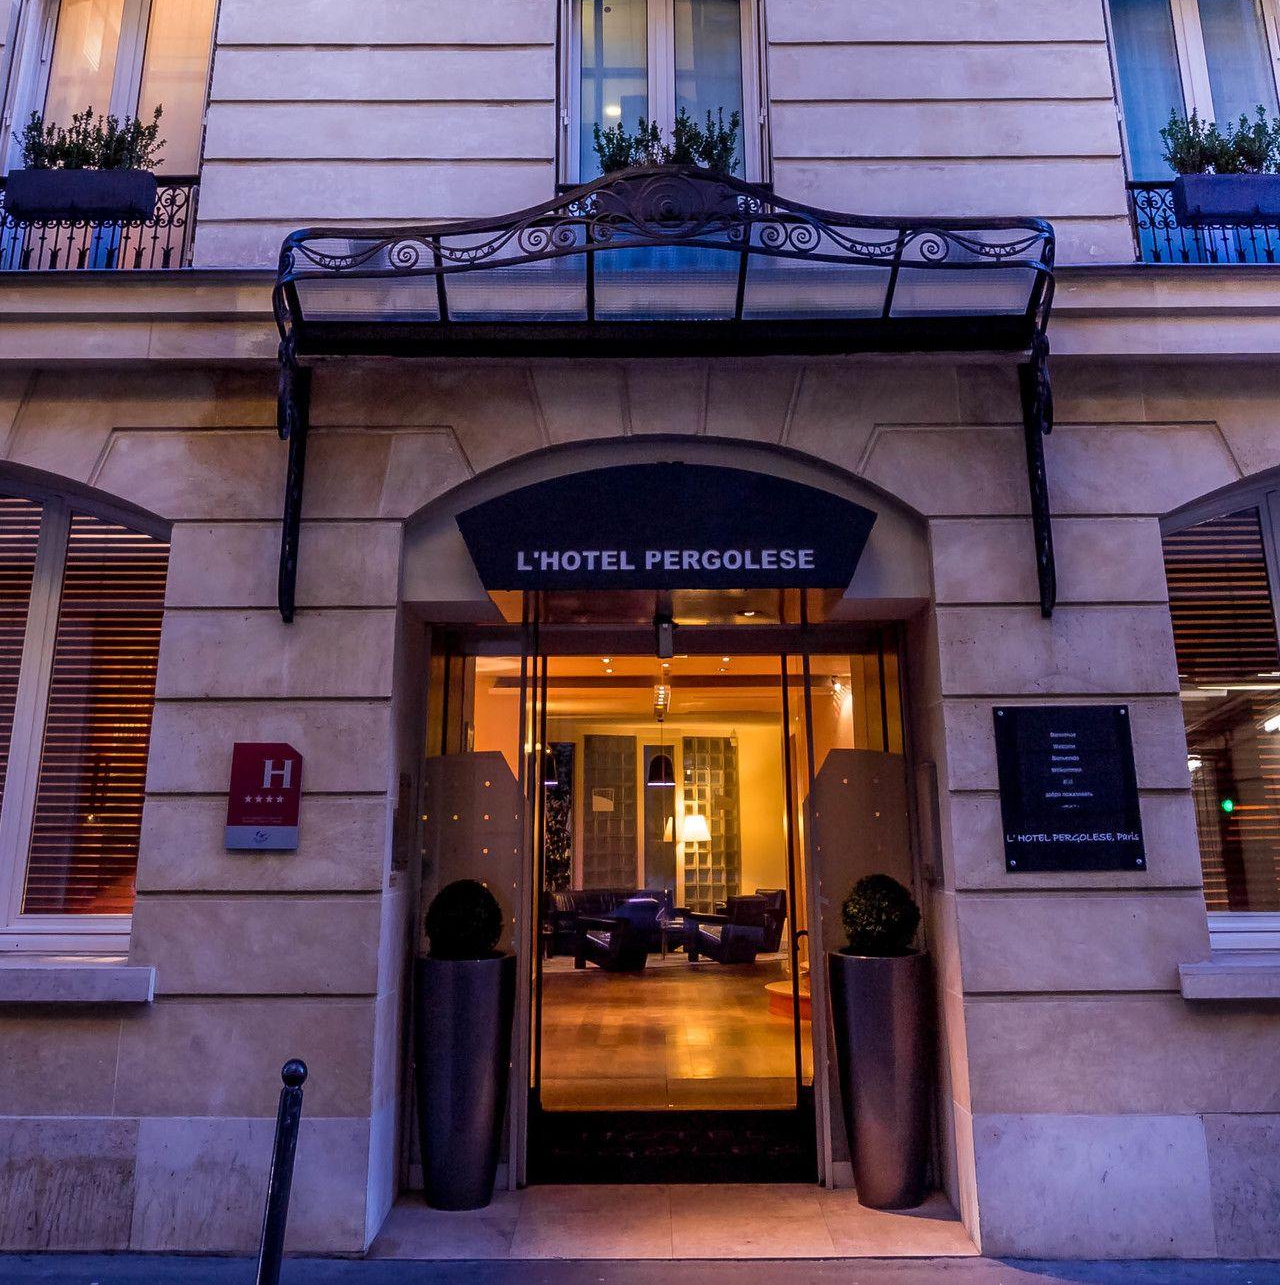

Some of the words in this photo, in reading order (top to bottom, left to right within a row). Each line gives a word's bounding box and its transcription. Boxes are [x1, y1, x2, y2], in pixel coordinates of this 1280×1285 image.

[517, 550, 635, 571] L'HOTEL
[645, 548, 816, 570] PERGOLESE
[262, 759, 294, 789] H
[1117, 831, 1140, 842] Paris
